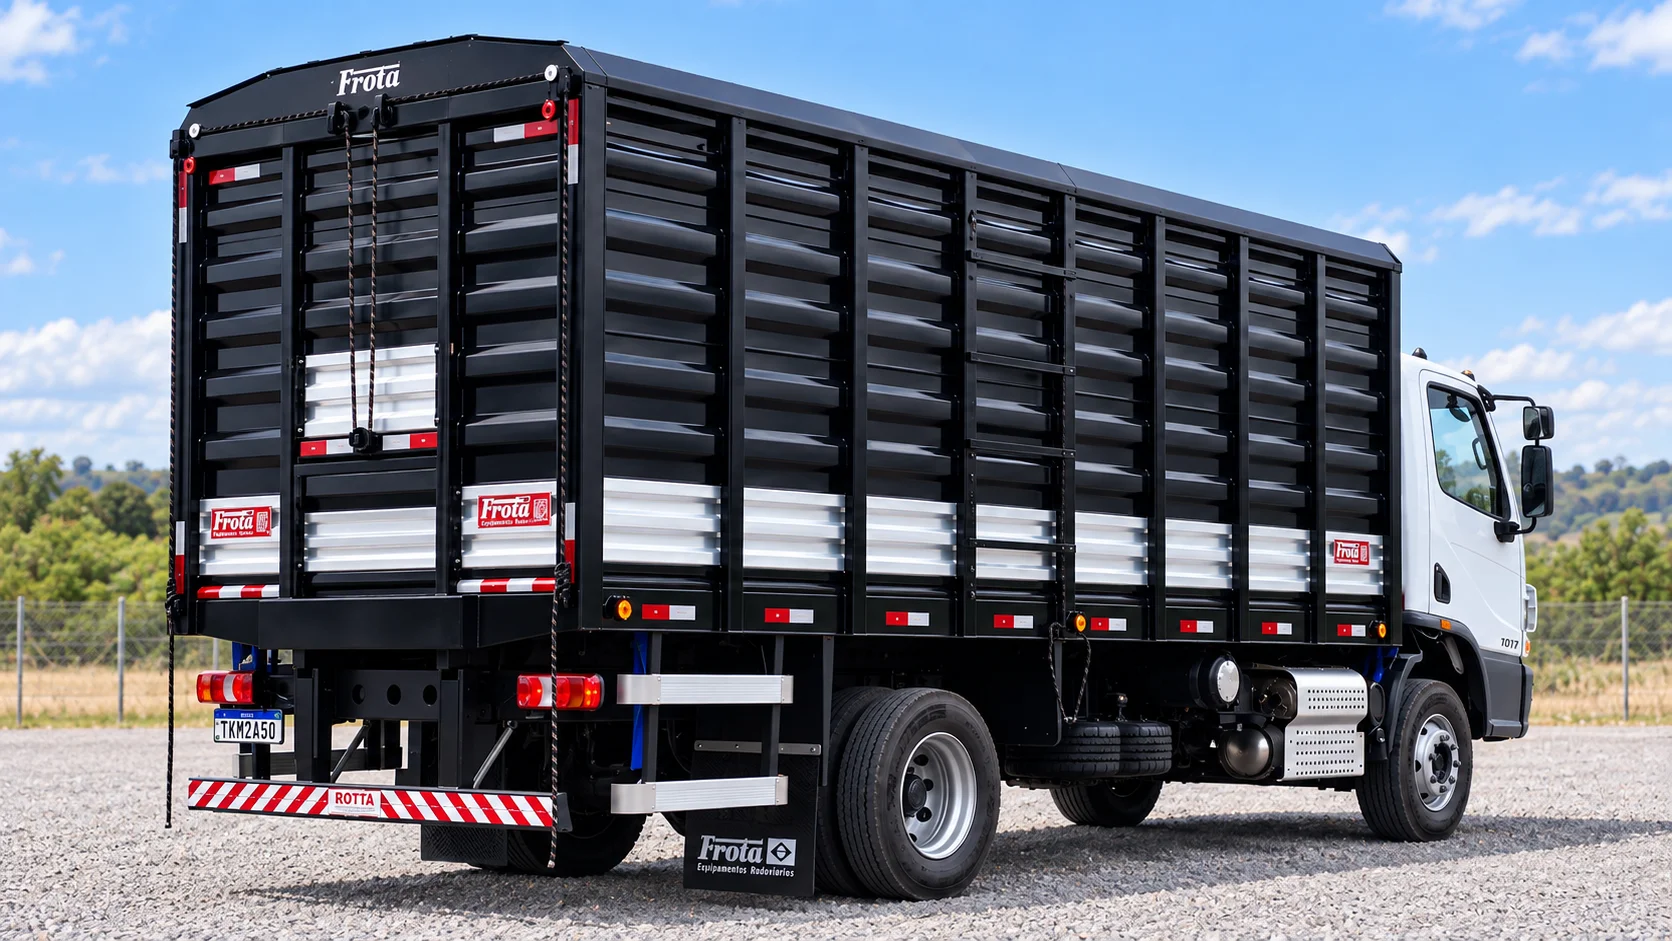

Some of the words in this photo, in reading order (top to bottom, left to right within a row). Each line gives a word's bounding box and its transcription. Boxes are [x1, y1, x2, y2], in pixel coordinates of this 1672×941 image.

[336, 62, 400, 96] Frota
[480, 496, 531, 519] Frota
[213, 510, 254, 531] Frota
[1501, 637, 1519, 650] 1017
[220, 720, 276, 740] TKM2A50
[335, 791, 375, 807] ROTTA
[697, 834, 764, 864] Frota
